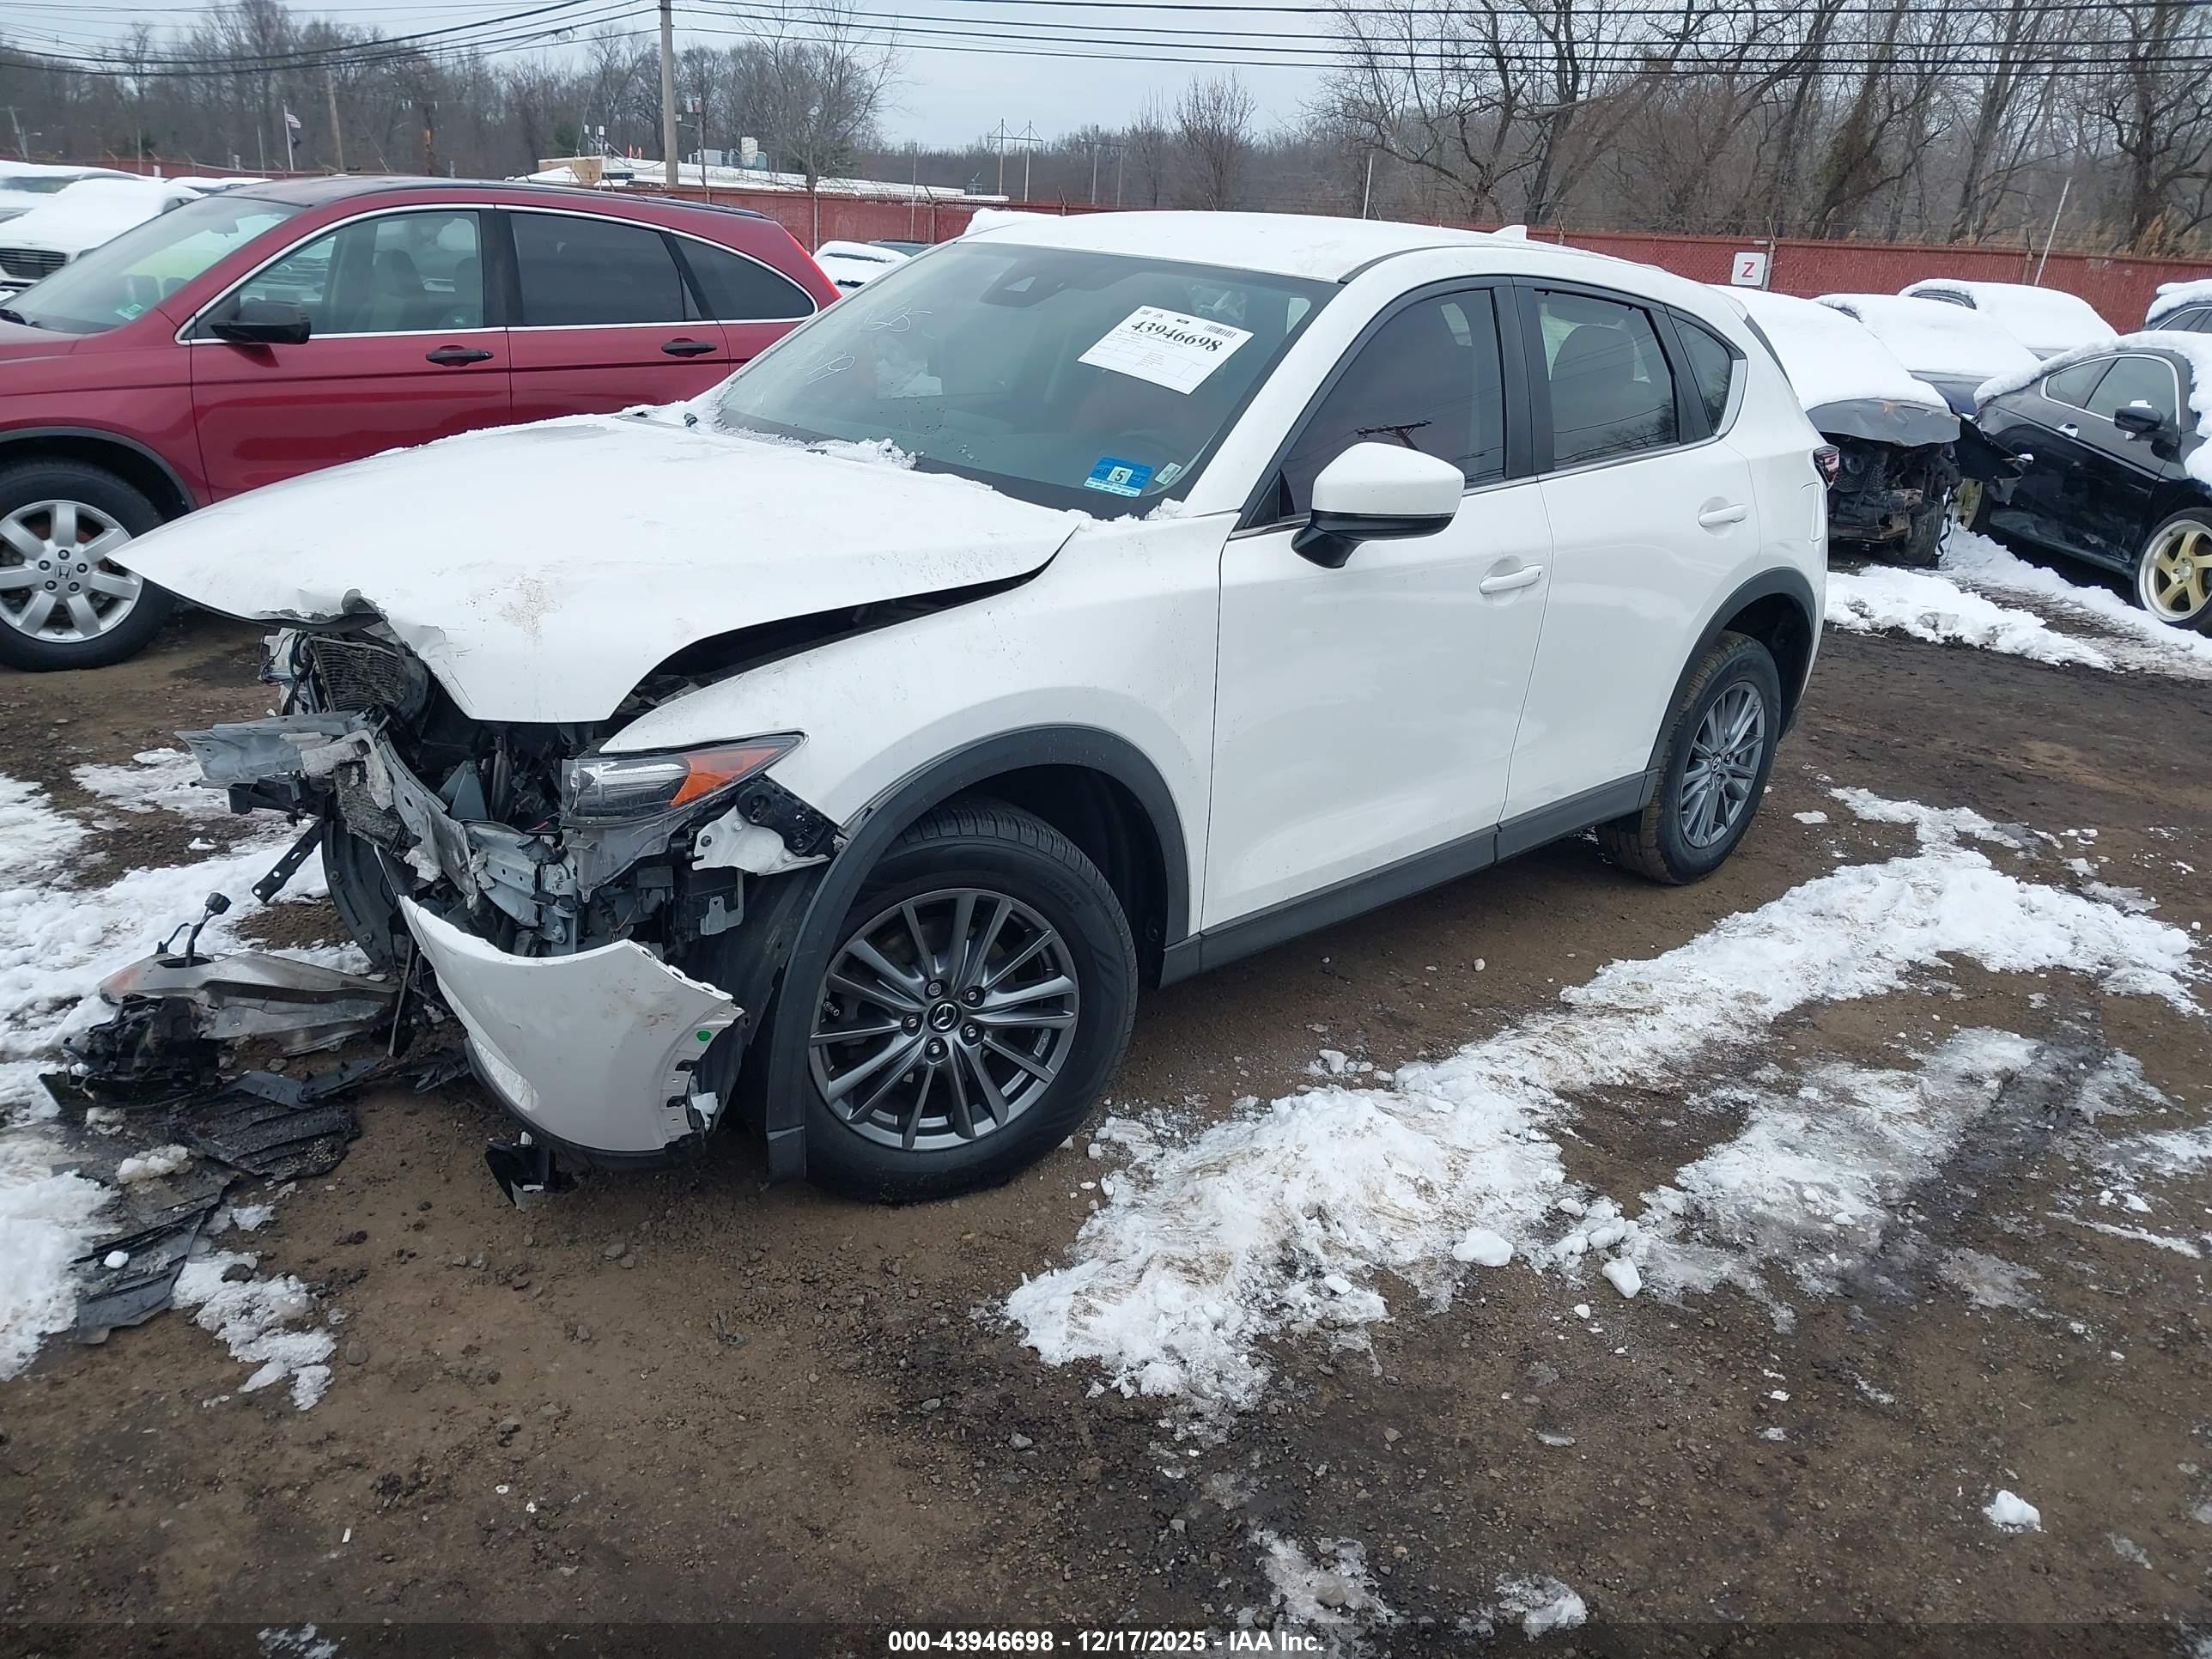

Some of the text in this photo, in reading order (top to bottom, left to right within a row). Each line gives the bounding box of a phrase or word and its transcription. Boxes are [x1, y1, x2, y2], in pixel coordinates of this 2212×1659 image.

[1741, 262, 1755, 277] Z
[1130, 320, 1223, 353] 43946698
[1115, 470, 1126, 482] 5
